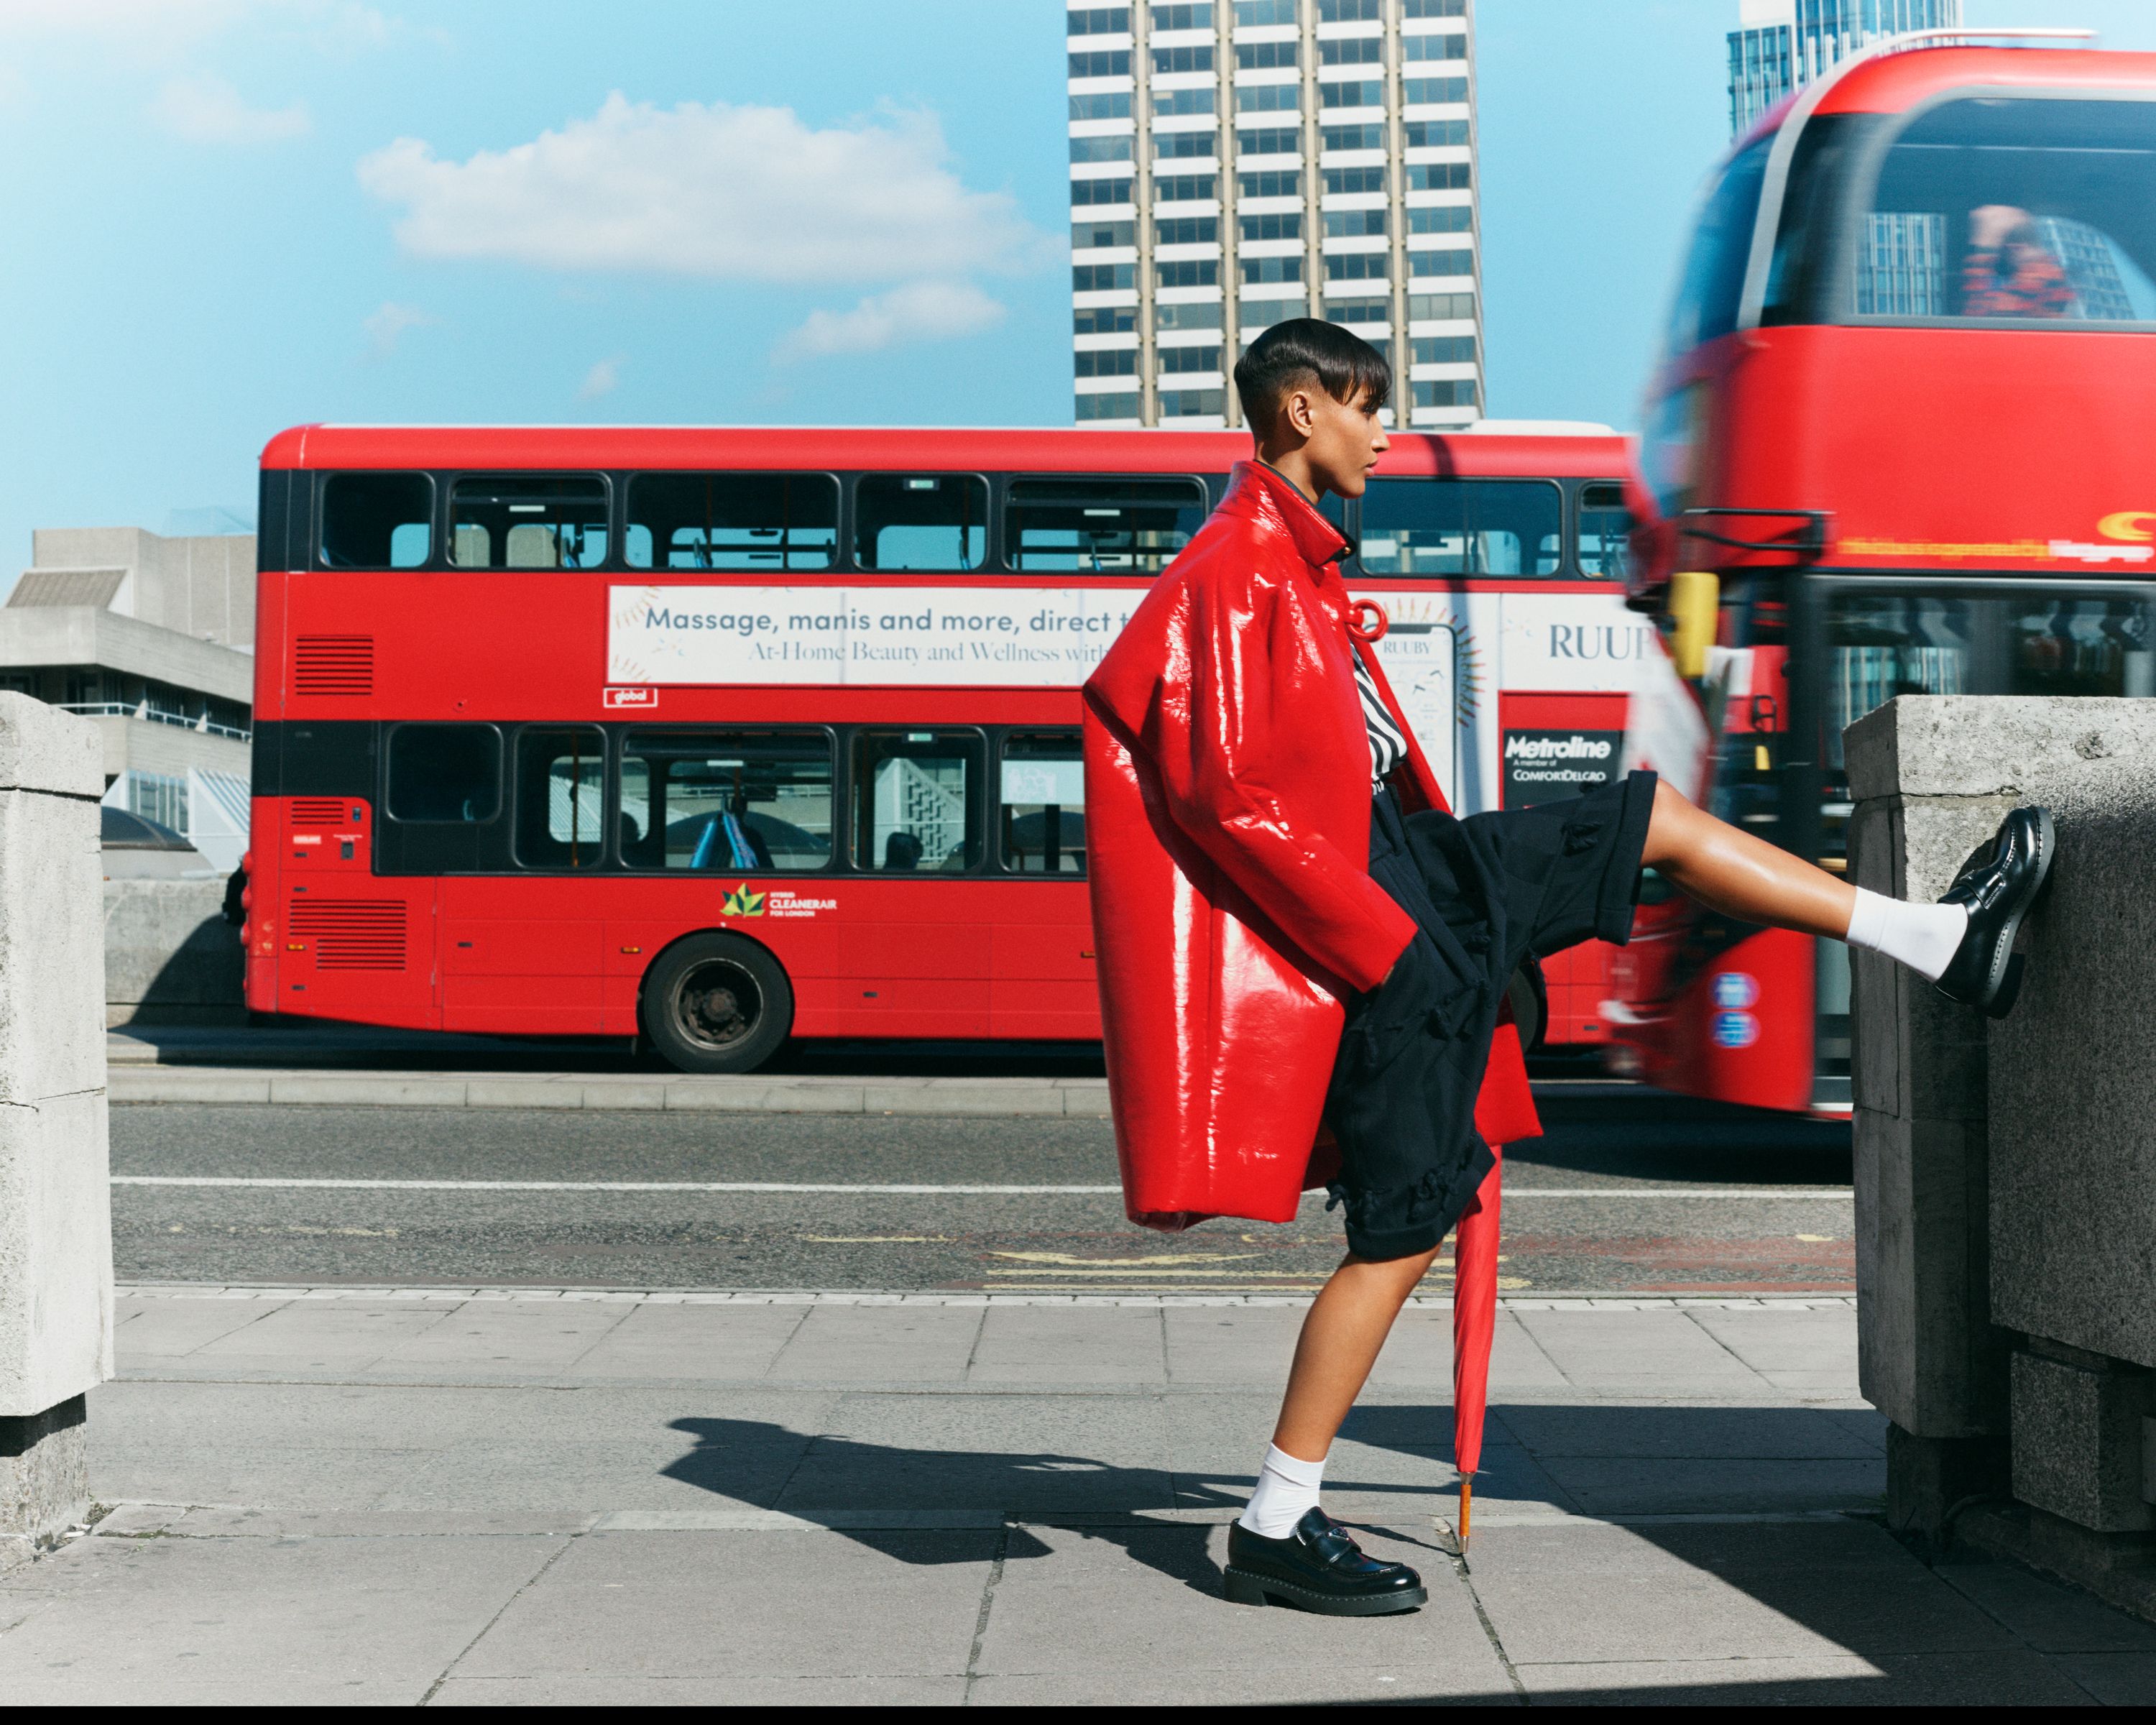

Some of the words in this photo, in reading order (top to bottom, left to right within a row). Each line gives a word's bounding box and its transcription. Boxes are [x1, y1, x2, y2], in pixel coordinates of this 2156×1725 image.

[645, 607, 779, 636] Massage,
[789, 609, 870, 630] manis
[880, 608, 931, 630] and
[942, 614, 1020, 635] more,
[1030, 610, 1111, 632] direct
[1120, 612, 1130, 630] t
[748, 641, 846, 661] At-Home
[852, 641, 921, 666] Beauty
[928, 642, 964, 661] and
[970, 642, 1059, 661] Wellness
[1383, 640, 1432, 655] RUUBY
[614, 689, 647, 704] global
[1505, 735, 1611, 759] Metroline
